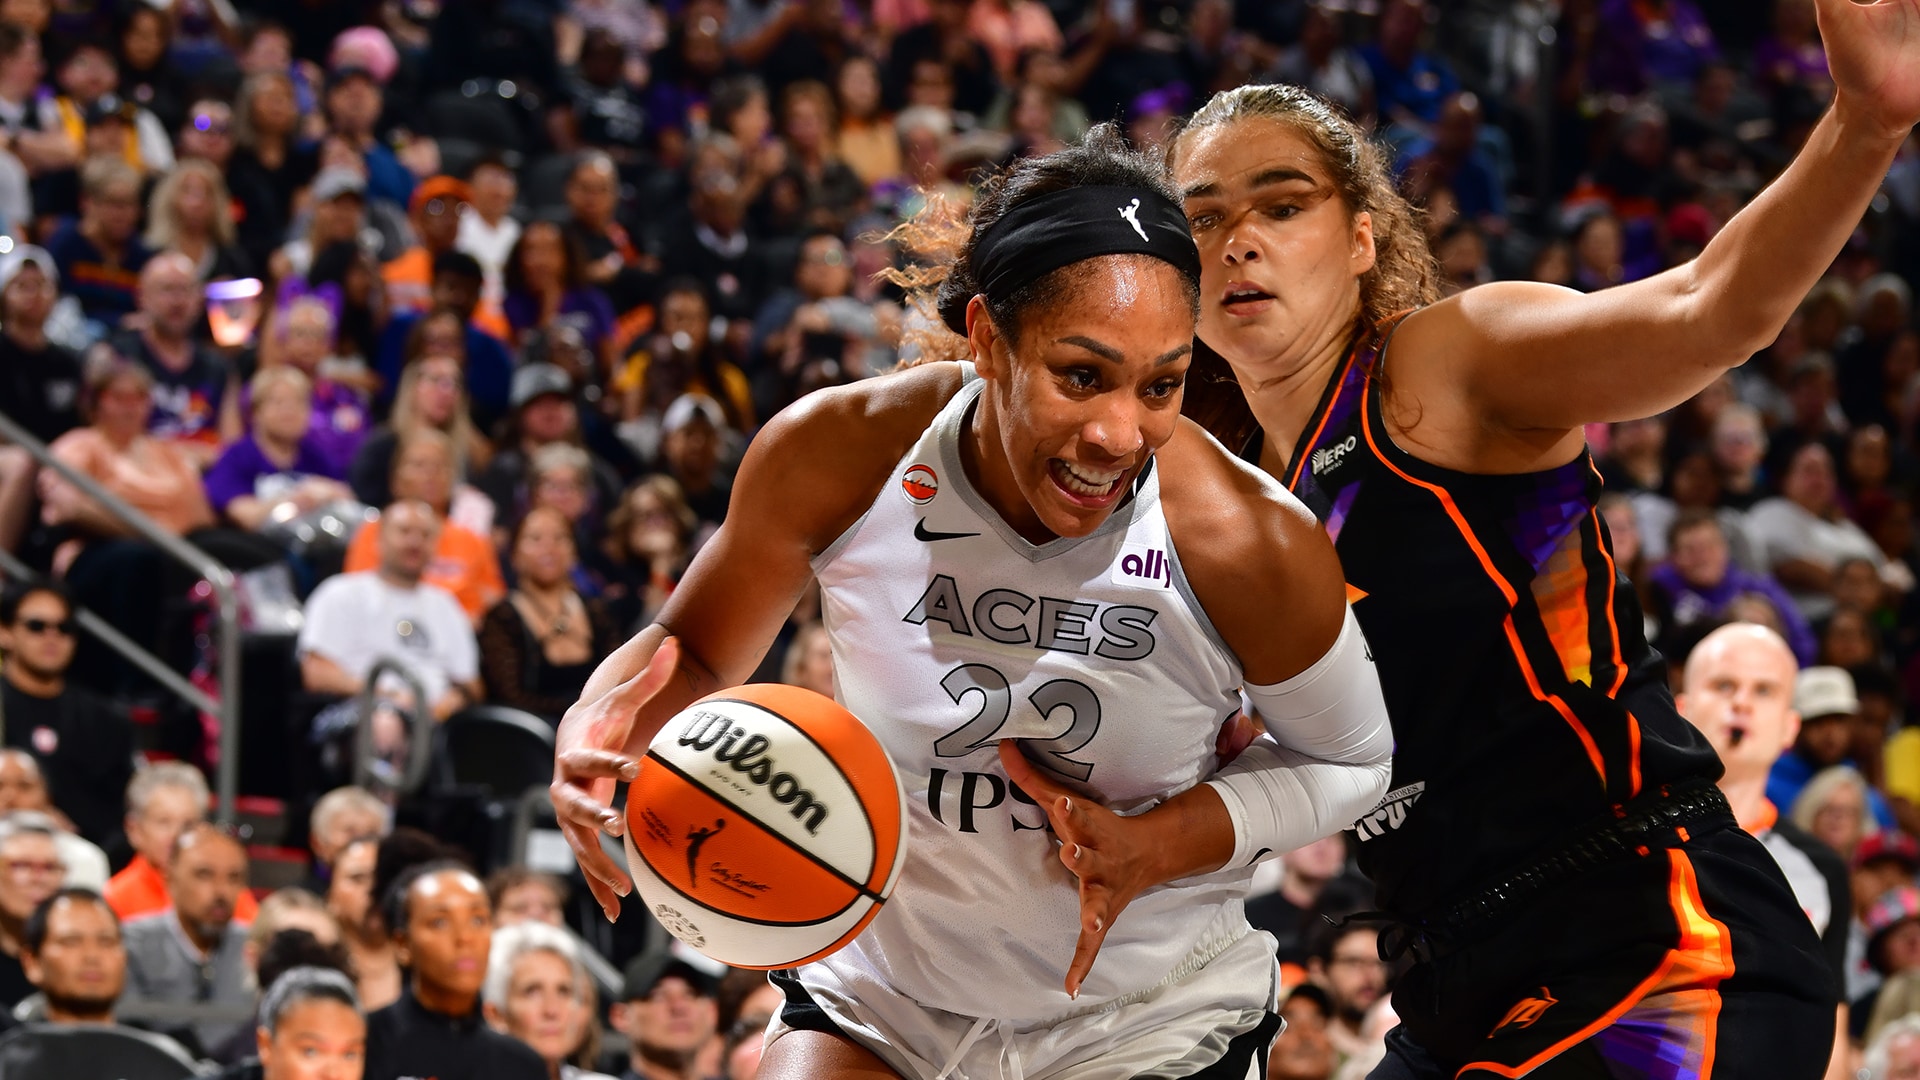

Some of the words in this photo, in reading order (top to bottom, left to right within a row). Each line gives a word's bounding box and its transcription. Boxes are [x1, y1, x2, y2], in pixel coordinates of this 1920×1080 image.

[1312, 435, 1357, 475] HERO
[1121, 548, 1171, 589] ally
[902, 573, 1159, 661] ACES
[934, 662, 1102, 783] 22
[677, 710, 829, 838] Wilson
[927, 767, 1055, 834] IPS
